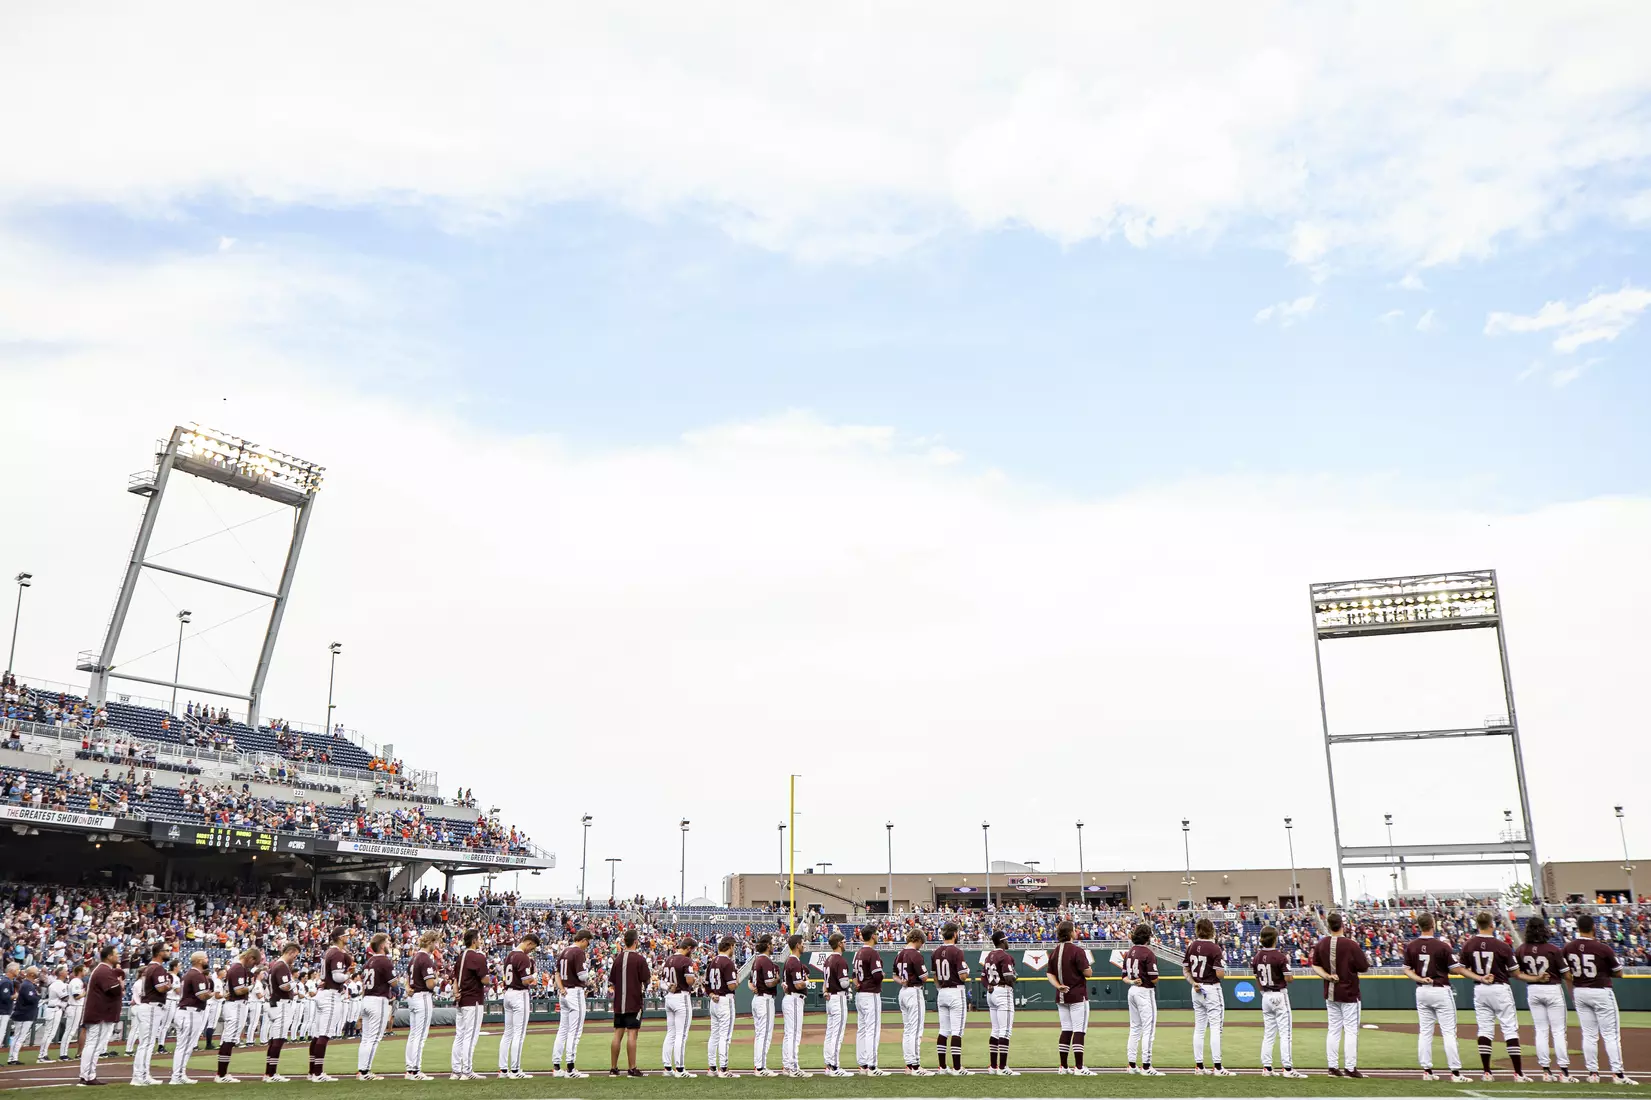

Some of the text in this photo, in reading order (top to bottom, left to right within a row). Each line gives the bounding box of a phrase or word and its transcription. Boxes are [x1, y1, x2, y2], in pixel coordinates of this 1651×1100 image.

[6, 808, 104, 826] THE GREATEST SHOW ON DIRT
[288, 840, 306, 850] #CWS
[358, 844, 381, 853] COLLEGE
[381, 846, 400, 855] WORLD
[400, 848, 419, 857] SERIES
[470, 853, 496, 863] GREATEST
[560, 958, 568, 981] 11
[935, 959, 951, 981] 10
[1126, 957, 1140, 980] 44
[1189, 955, 1208, 978] 27
[1418, 954, 1431, 977] 7
[1472, 951, 1495, 975] 17
[1523, 955, 1550, 976] 32
[1568, 953, 1598, 978] 35
[709, 968, 722, 990] 43
[1256, 963, 1275, 987] 31
